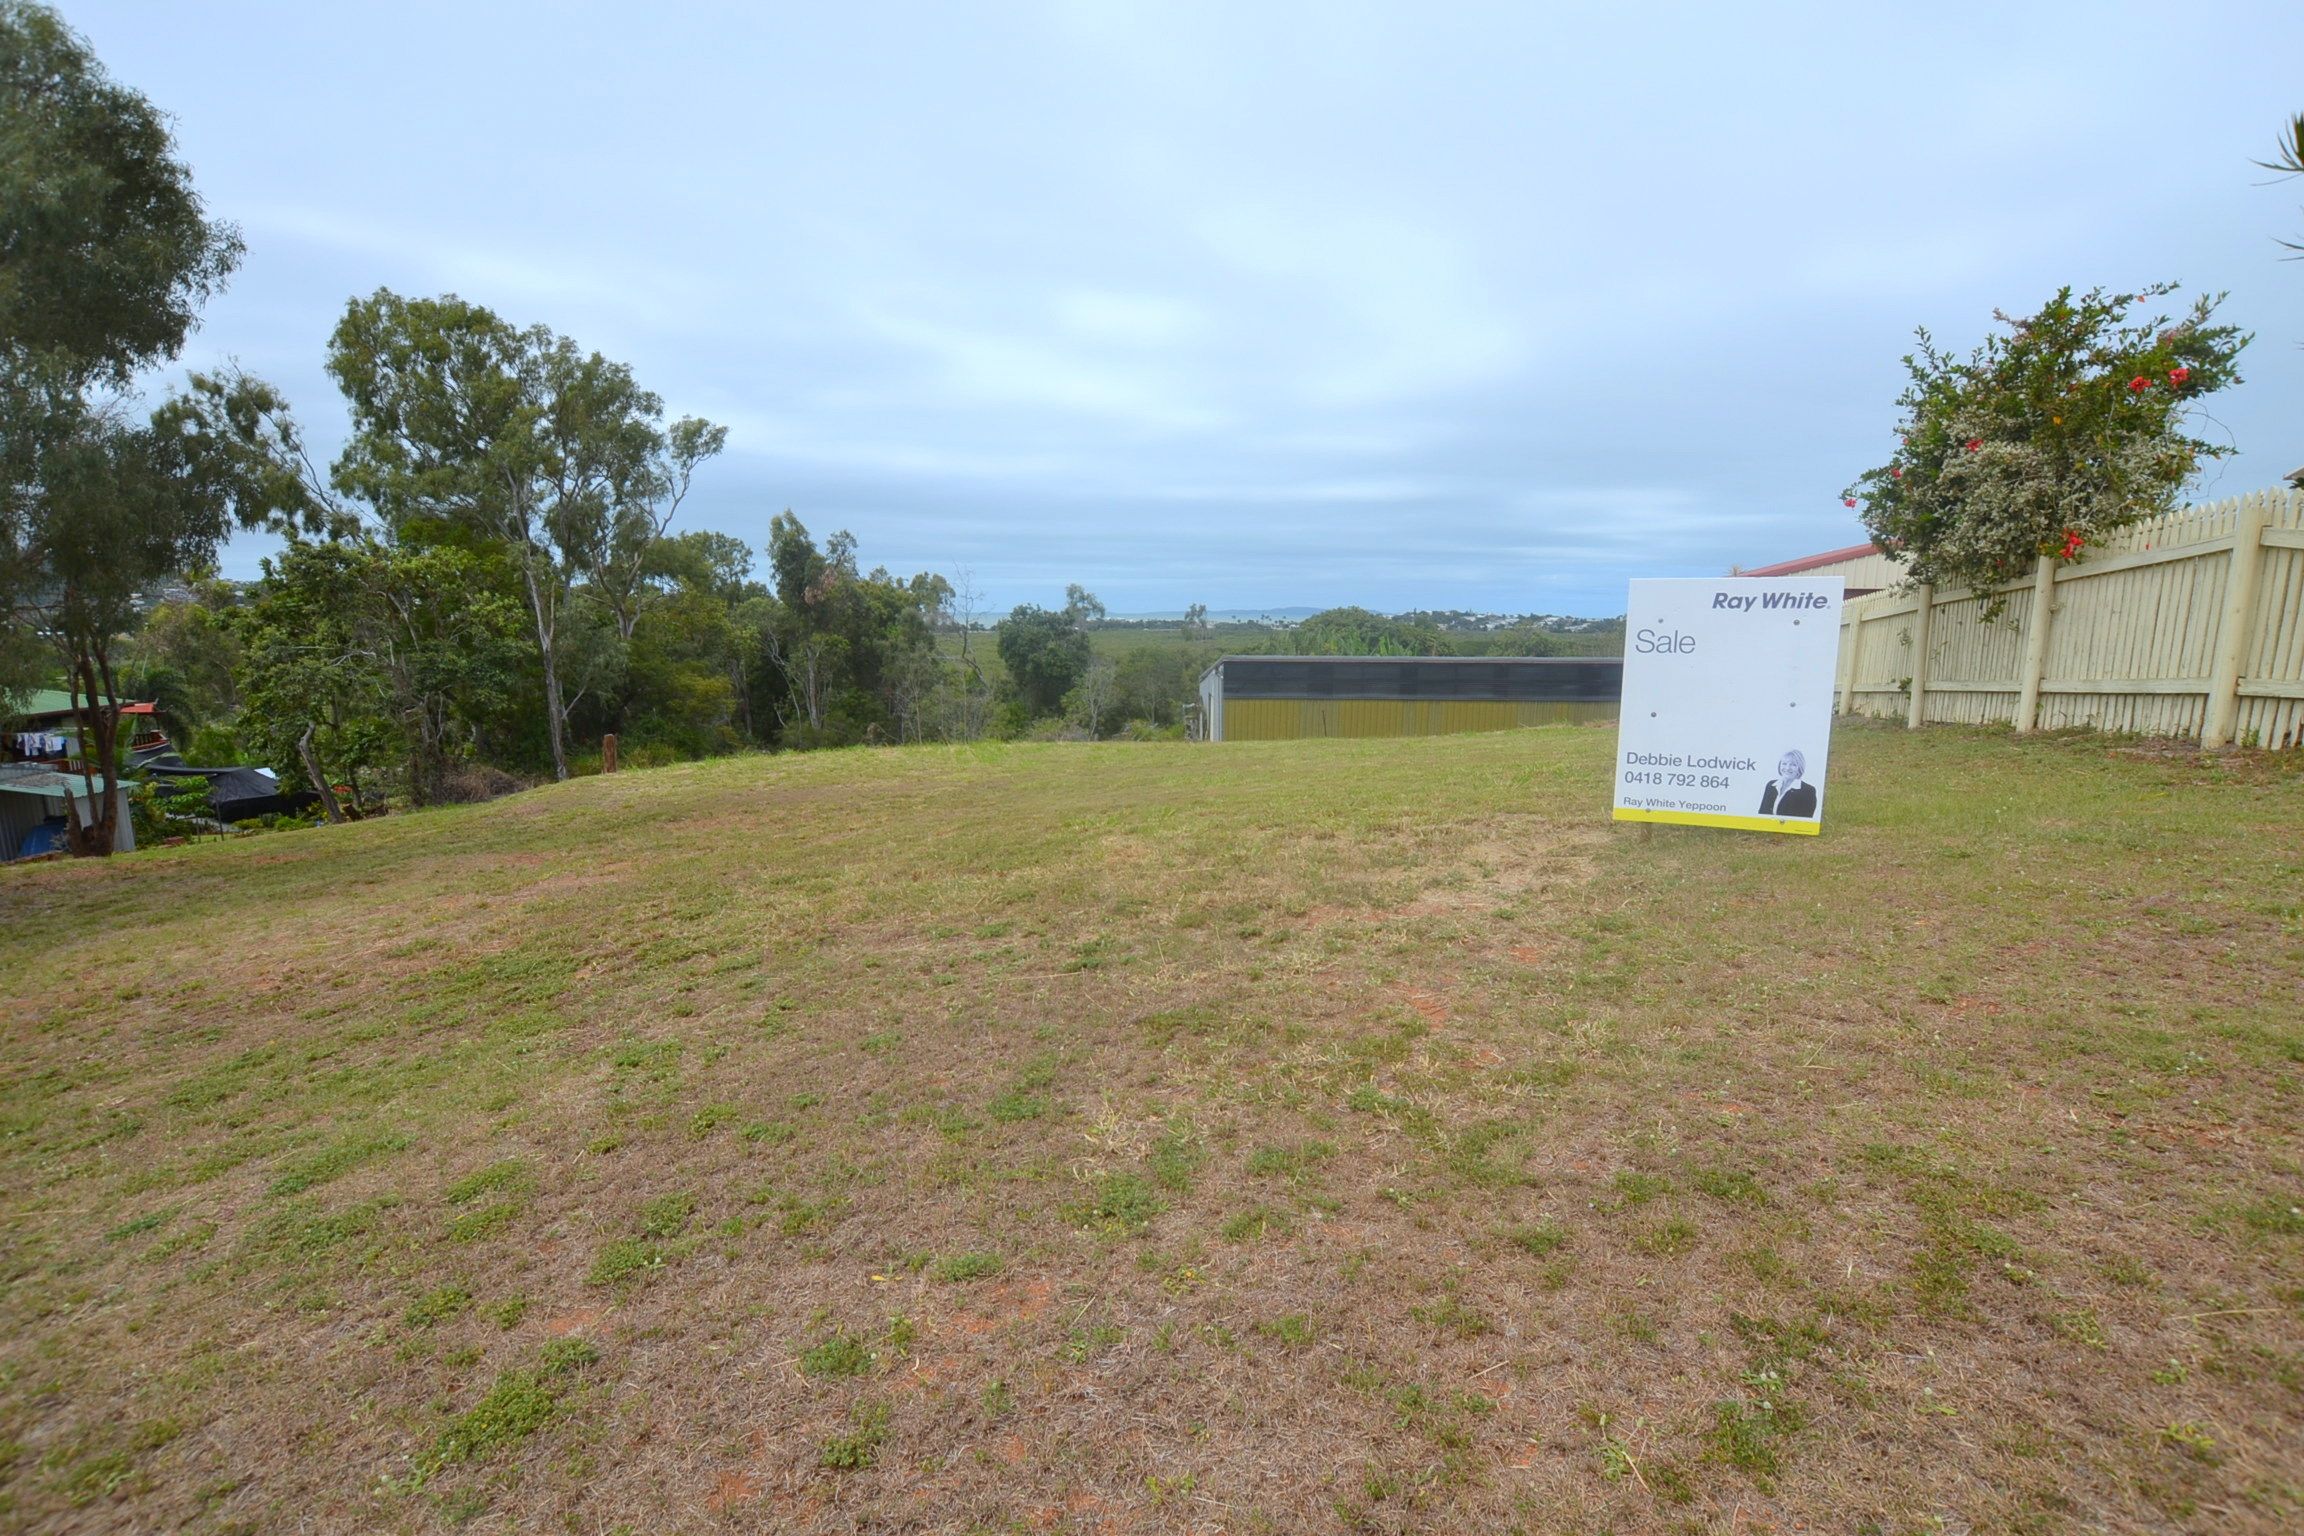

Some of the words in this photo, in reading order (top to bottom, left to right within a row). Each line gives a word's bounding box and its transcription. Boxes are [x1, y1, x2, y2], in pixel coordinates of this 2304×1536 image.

[1712, 592, 1757, 612] Ray
[1635, 629, 1696, 654] Sale
[1626, 752, 1682, 767] Debbie
[1687, 755, 1756, 771] Lodwick
[1625, 771, 1662, 785] 0418
[1667, 774, 1696, 787] 792
[1700, 775, 1729, 788] 864
[1624, 797, 1643, 808] Ray
[1646, 798, 1676, 808] White
[1678, 800, 1726, 812] Yeppoon
